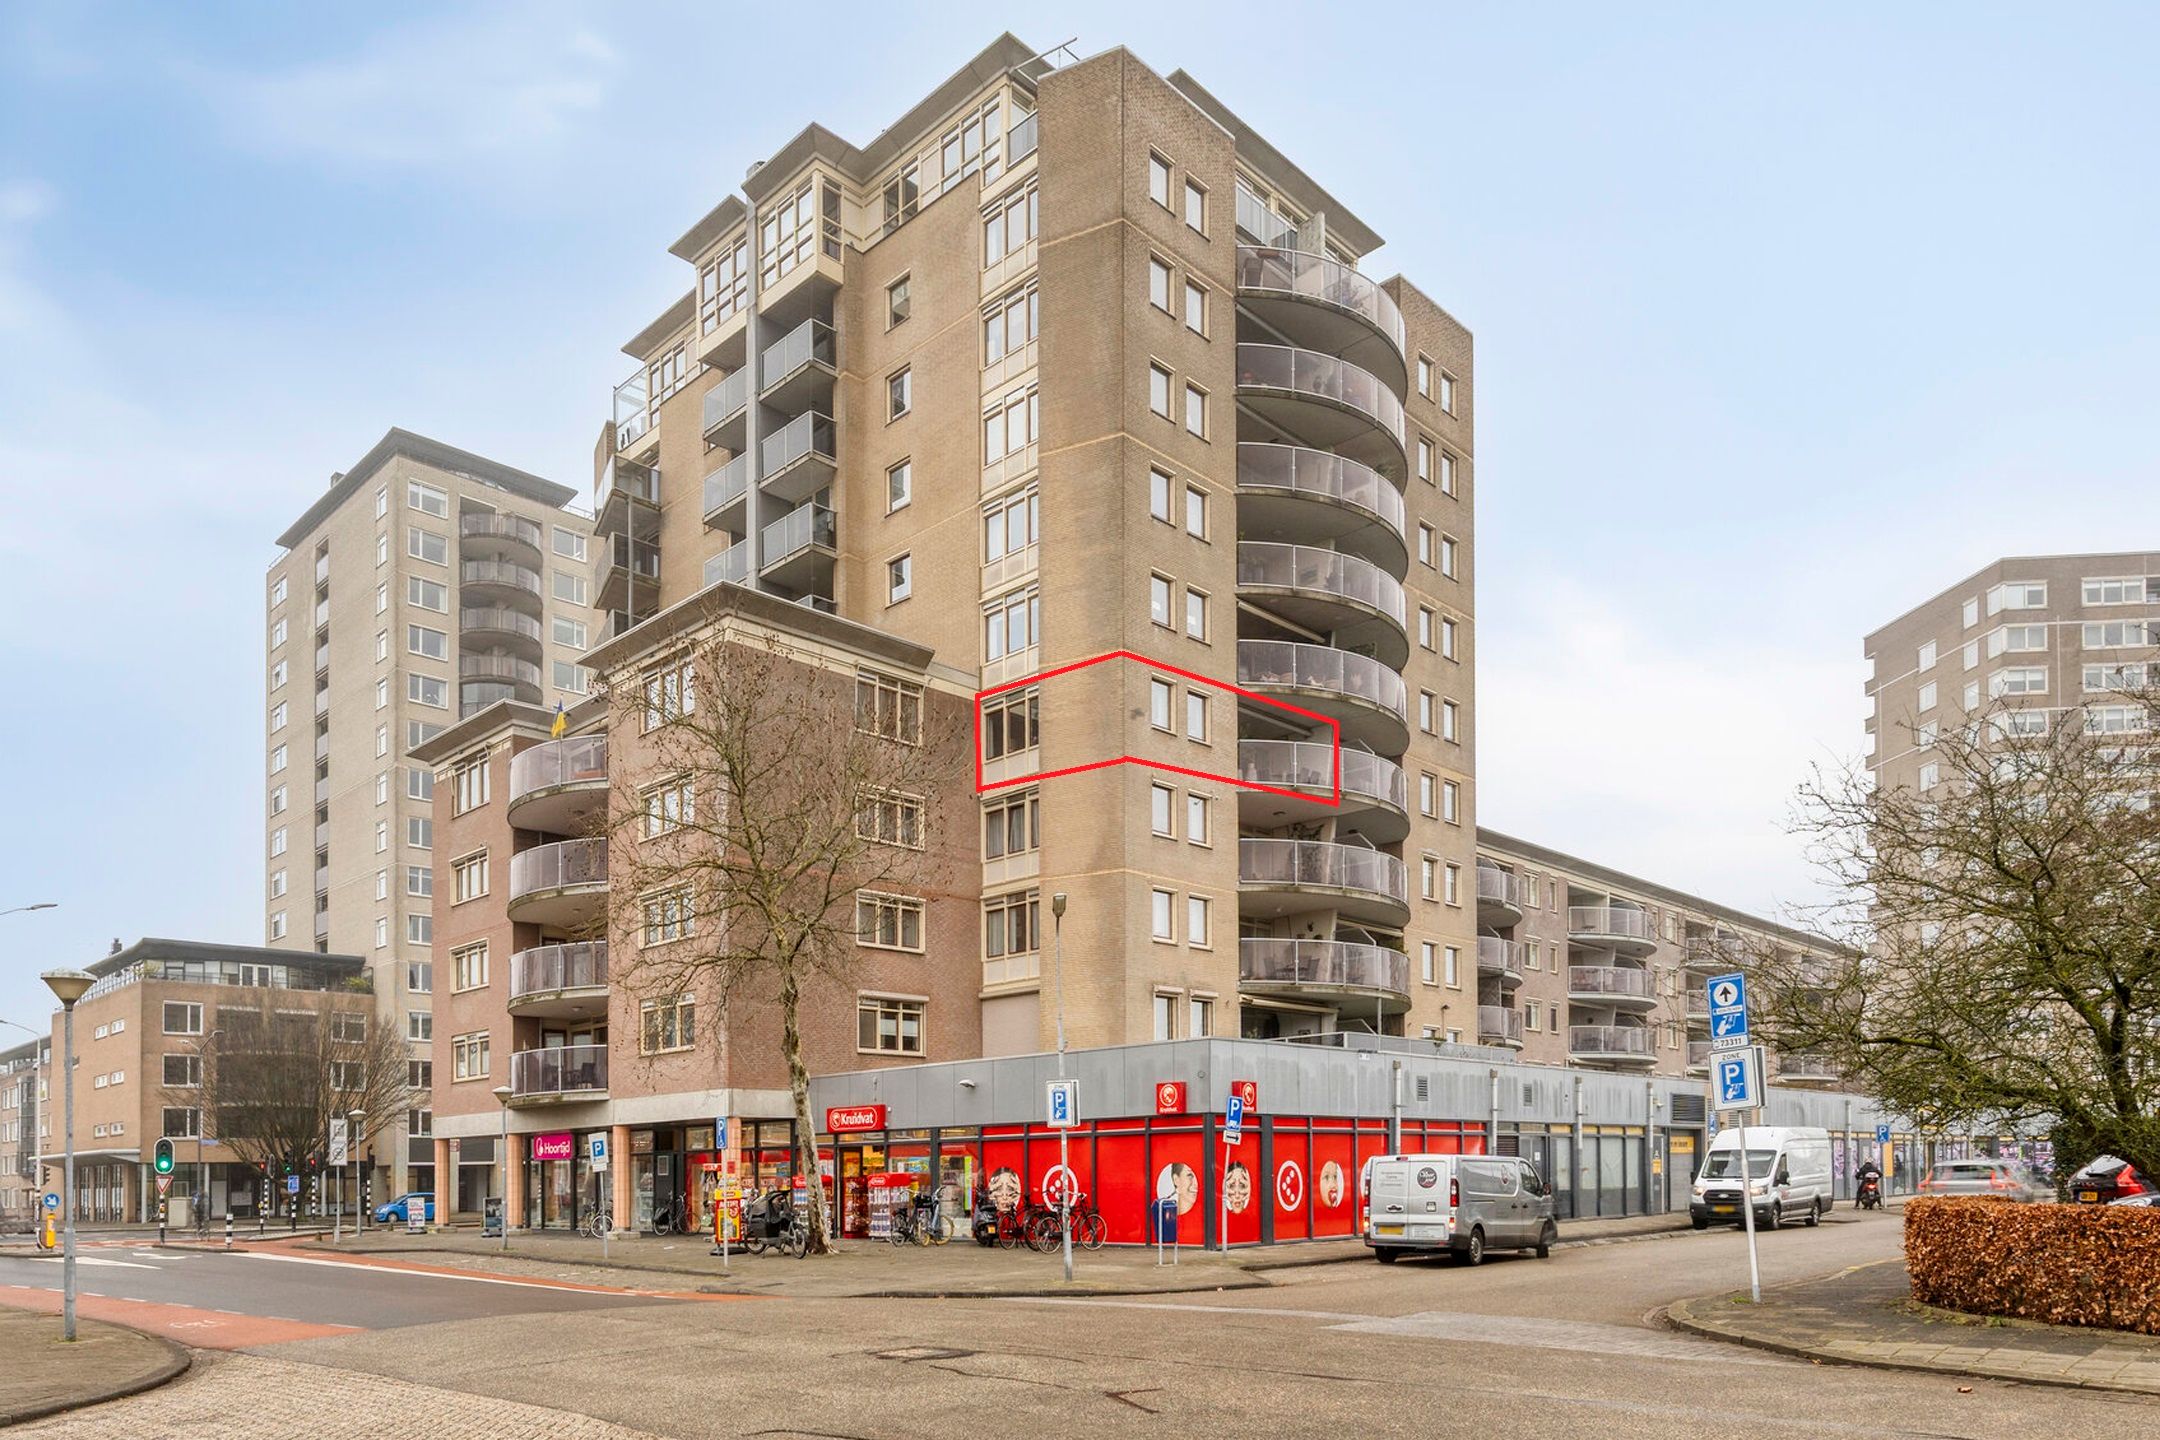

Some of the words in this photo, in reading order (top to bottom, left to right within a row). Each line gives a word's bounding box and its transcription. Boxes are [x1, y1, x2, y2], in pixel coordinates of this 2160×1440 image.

[1720, 1038, 1742, 1047] 73311
[1722, 1053, 1741, 1061] ZONE
[1725, 1064, 1740, 1085] P
[1055, 1093, 1064, 1108] P
[1230, 1099, 1240, 1117] P
[841, 1111, 874, 1125] Kruidvat
[1879, 1126, 1887, 1136] P
[544, 1141, 571, 1156] Hoortijd
[594, 1142, 603, 1156] P
